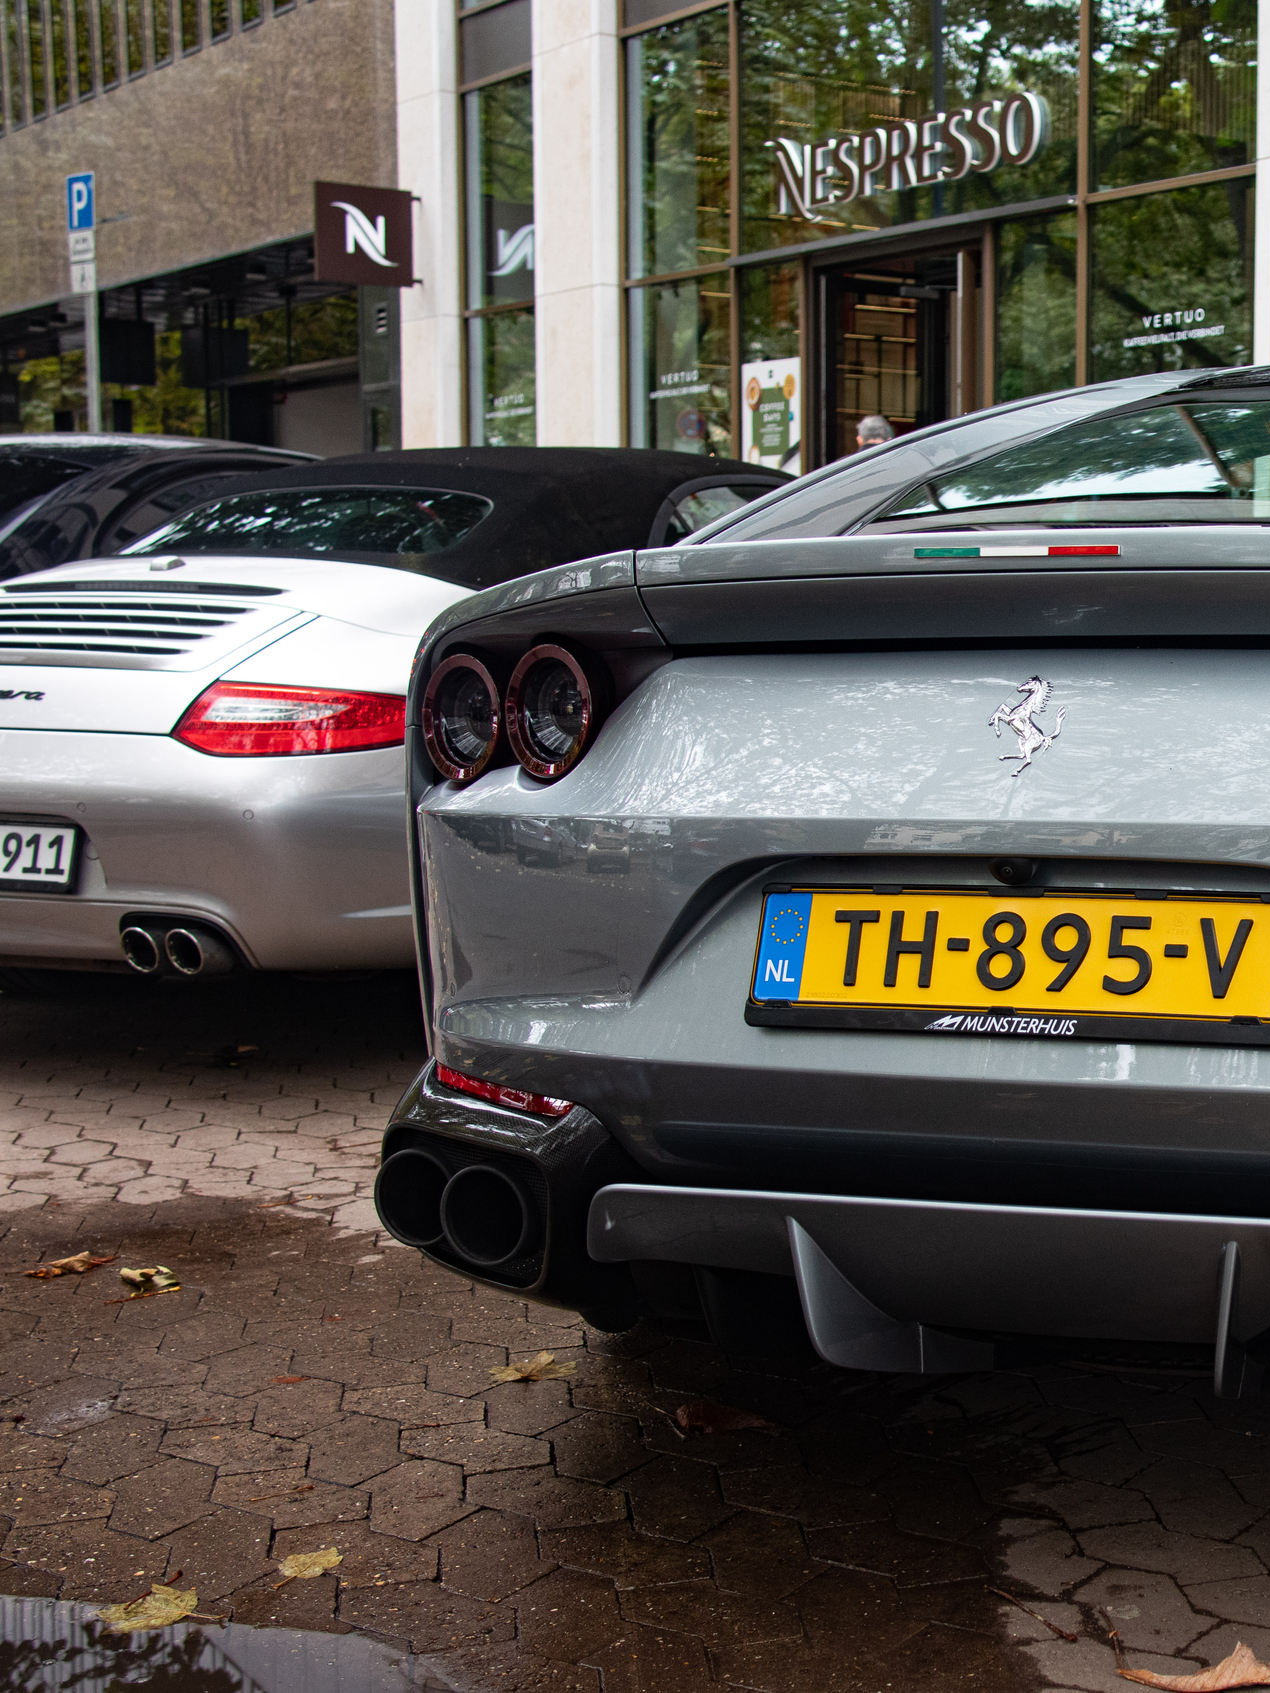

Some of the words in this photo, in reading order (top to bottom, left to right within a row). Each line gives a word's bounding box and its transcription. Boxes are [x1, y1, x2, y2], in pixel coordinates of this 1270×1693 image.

[764, 91, 1042, 222] NESPRESSO
[71, 181, 88, 228] P
[330, 201, 399, 267] N
[1142, 308, 1205, 329] VERTUO
[660, 370, 699, 385] VERTUO
[2, 832, 64, 875] 911
[764, 959, 795, 982] NL
[834, 910, 1254, 999] TH-895-V
[961, 1016, 1077, 1035] MUNSTERHUIS
